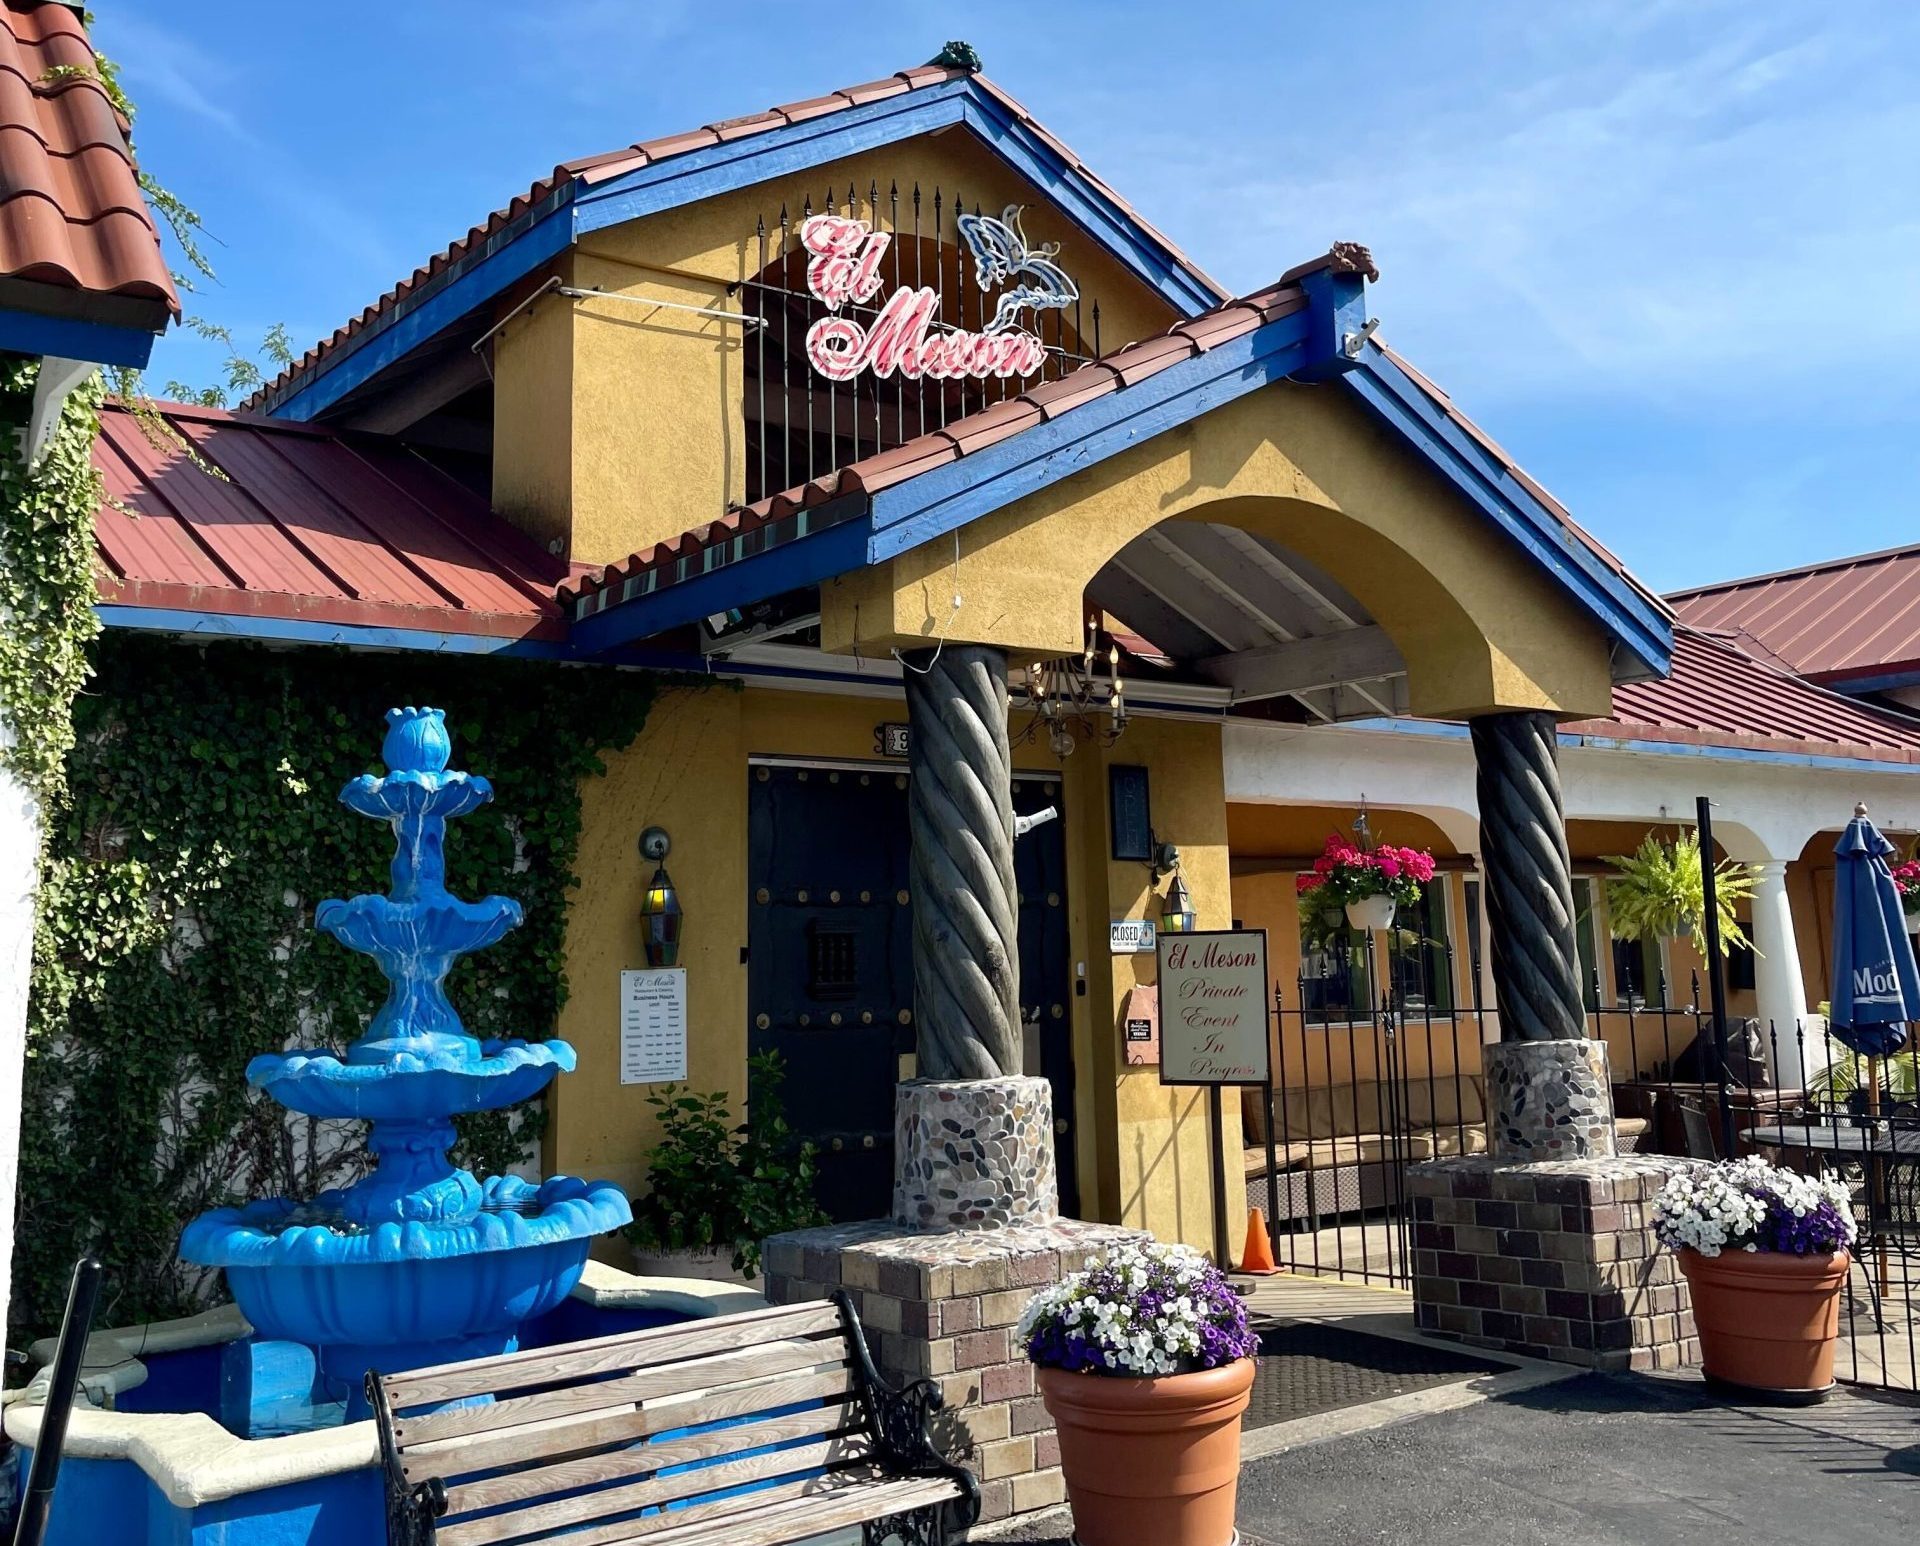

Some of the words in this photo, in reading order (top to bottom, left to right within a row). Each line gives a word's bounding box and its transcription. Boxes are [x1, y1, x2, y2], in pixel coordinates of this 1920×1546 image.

[801, 214, 891, 311] El
[806, 286, 1048, 381] Meson
[1112, 926, 1138, 941] CLOSED
[1168, 942, 1189, 970] El
[1192, 942, 1257, 970] Meson
[1179, 977, 1248, 1000] Private
[1180, 1006, 1239, 1029] Event
[1193, 1031, 1225, 1054] In
[1190, 1057, 1256, 1080] Progress
